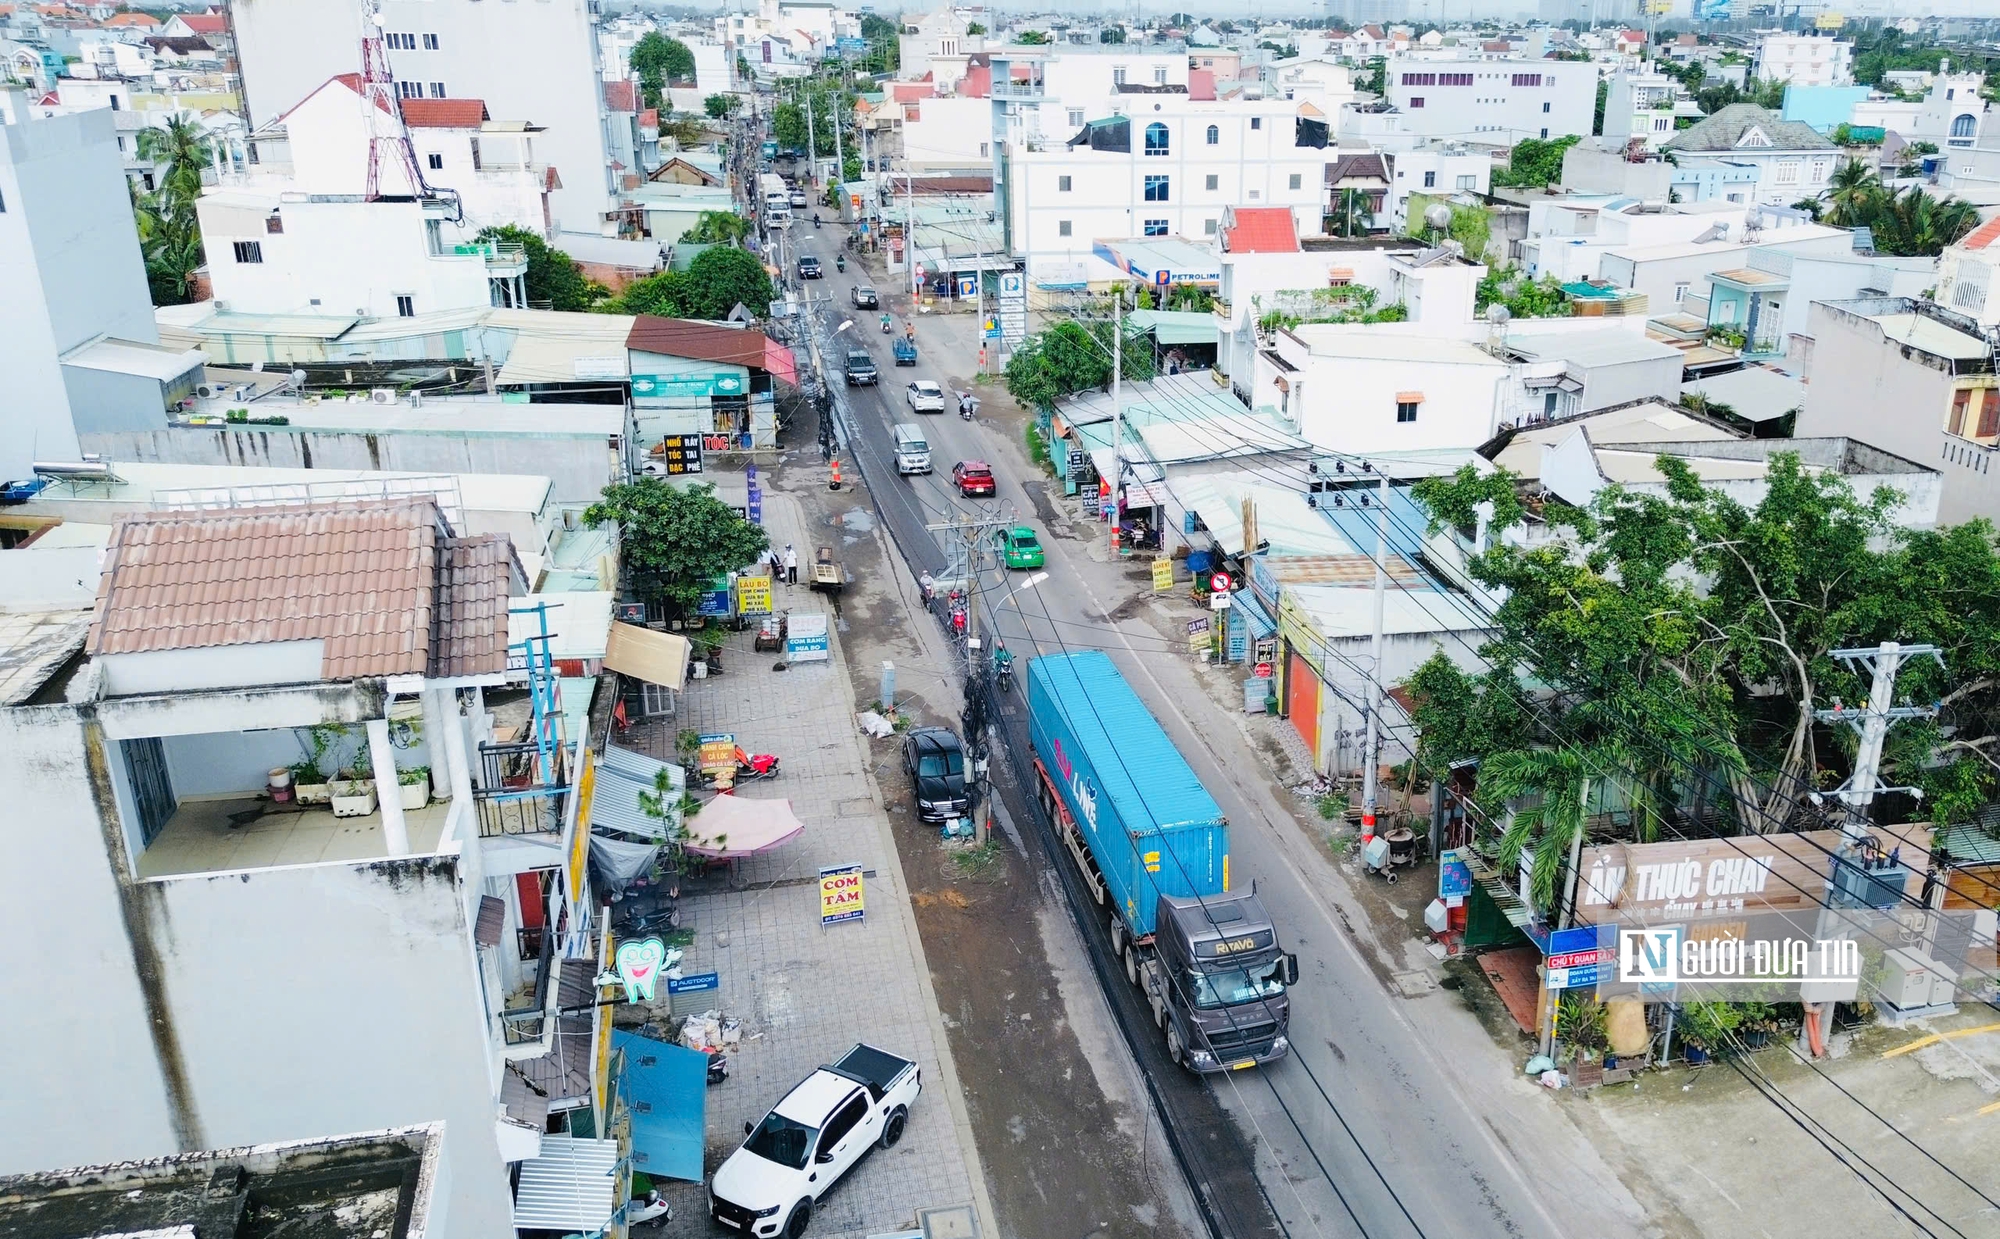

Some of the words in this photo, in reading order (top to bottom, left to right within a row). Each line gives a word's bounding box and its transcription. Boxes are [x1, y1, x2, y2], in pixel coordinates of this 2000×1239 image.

[1172, 273, 1220, 281] PETROLIME
[704, 433, 729, 451] TÓC
[667, 449, 682, 460] TÓC
[686, 450, 697, 459] TAI
[668, 463, 684, 474] BẠC
[824, 876, 858, 890] CƠM
[1636, 857, 1702, 905] THỰC
[1706, 856, 1774, 897] CHAY
[824, 890, 860, 905] TẤM
[1551, 953, 1568, 967] CHÚ
[1568, 955, 1574, 964] Ý
[1574, 953, 1596, 964] QUAN
[678, 976, 716, 986] AUSTDOOR
